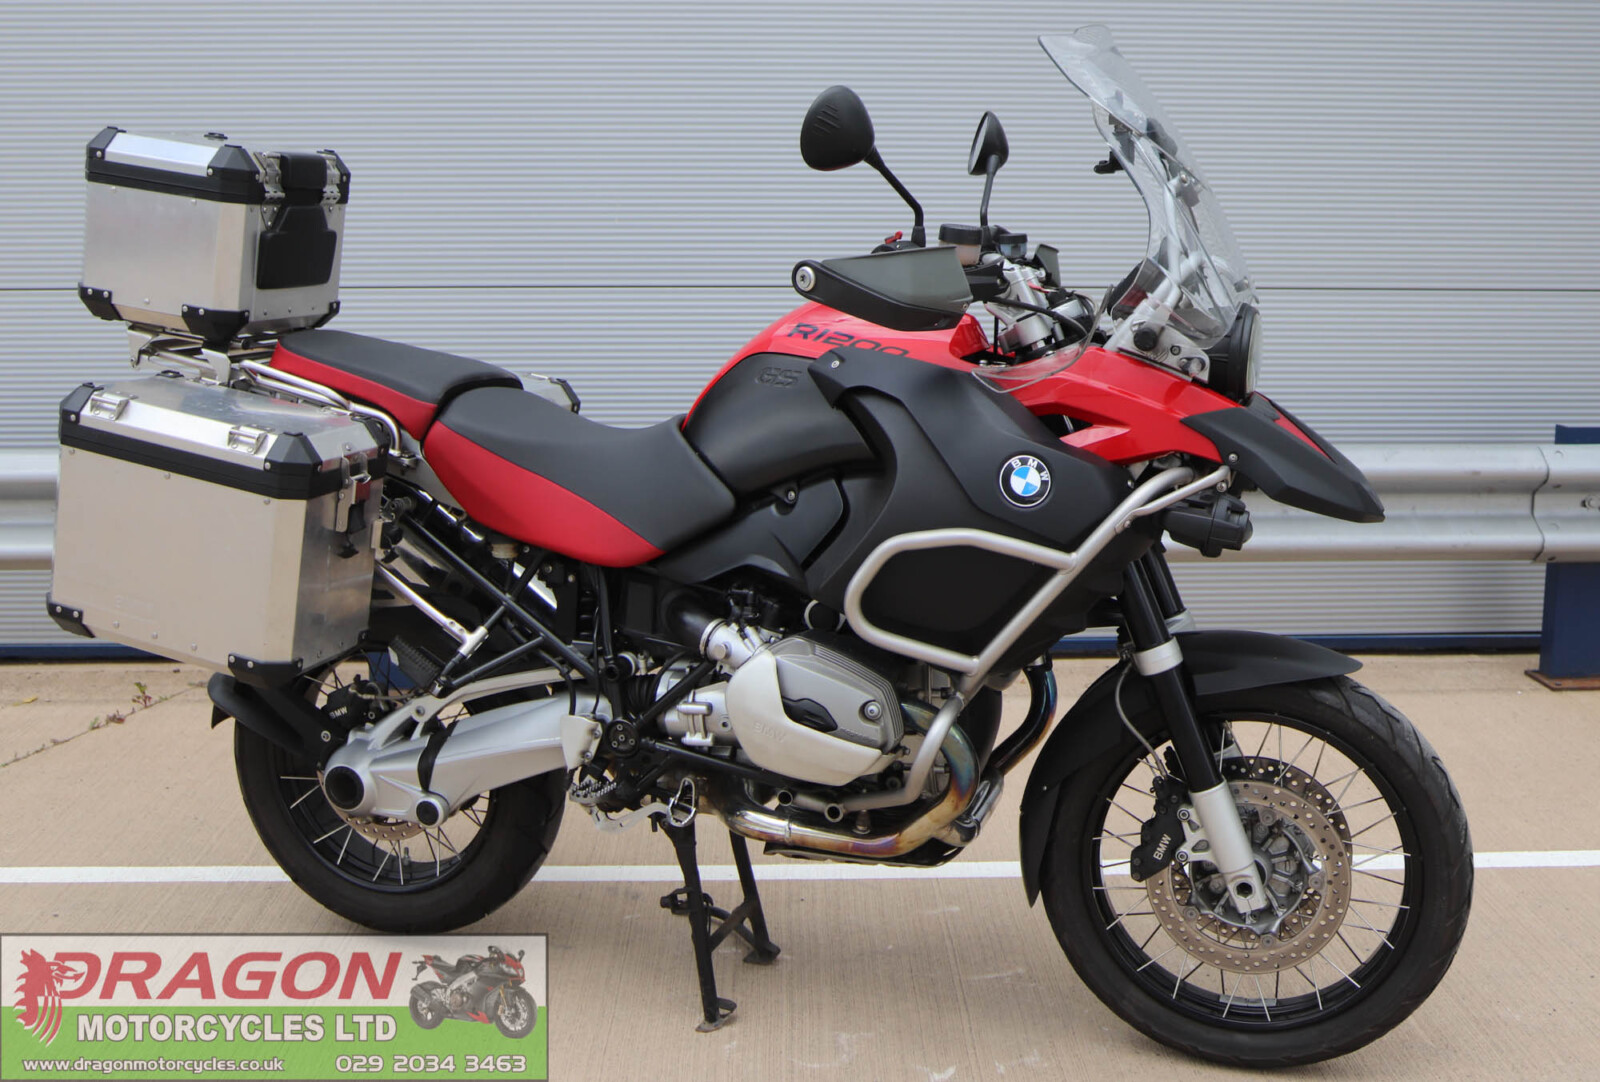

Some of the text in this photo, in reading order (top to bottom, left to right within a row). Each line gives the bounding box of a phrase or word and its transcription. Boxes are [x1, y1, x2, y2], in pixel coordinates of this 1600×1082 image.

[755, 366, 803, 389] GS
[1010, 458, 1049, 481] BMW
[329, 705, 348, 719] BMW
[1153, 833, 1172, 861] BMW
